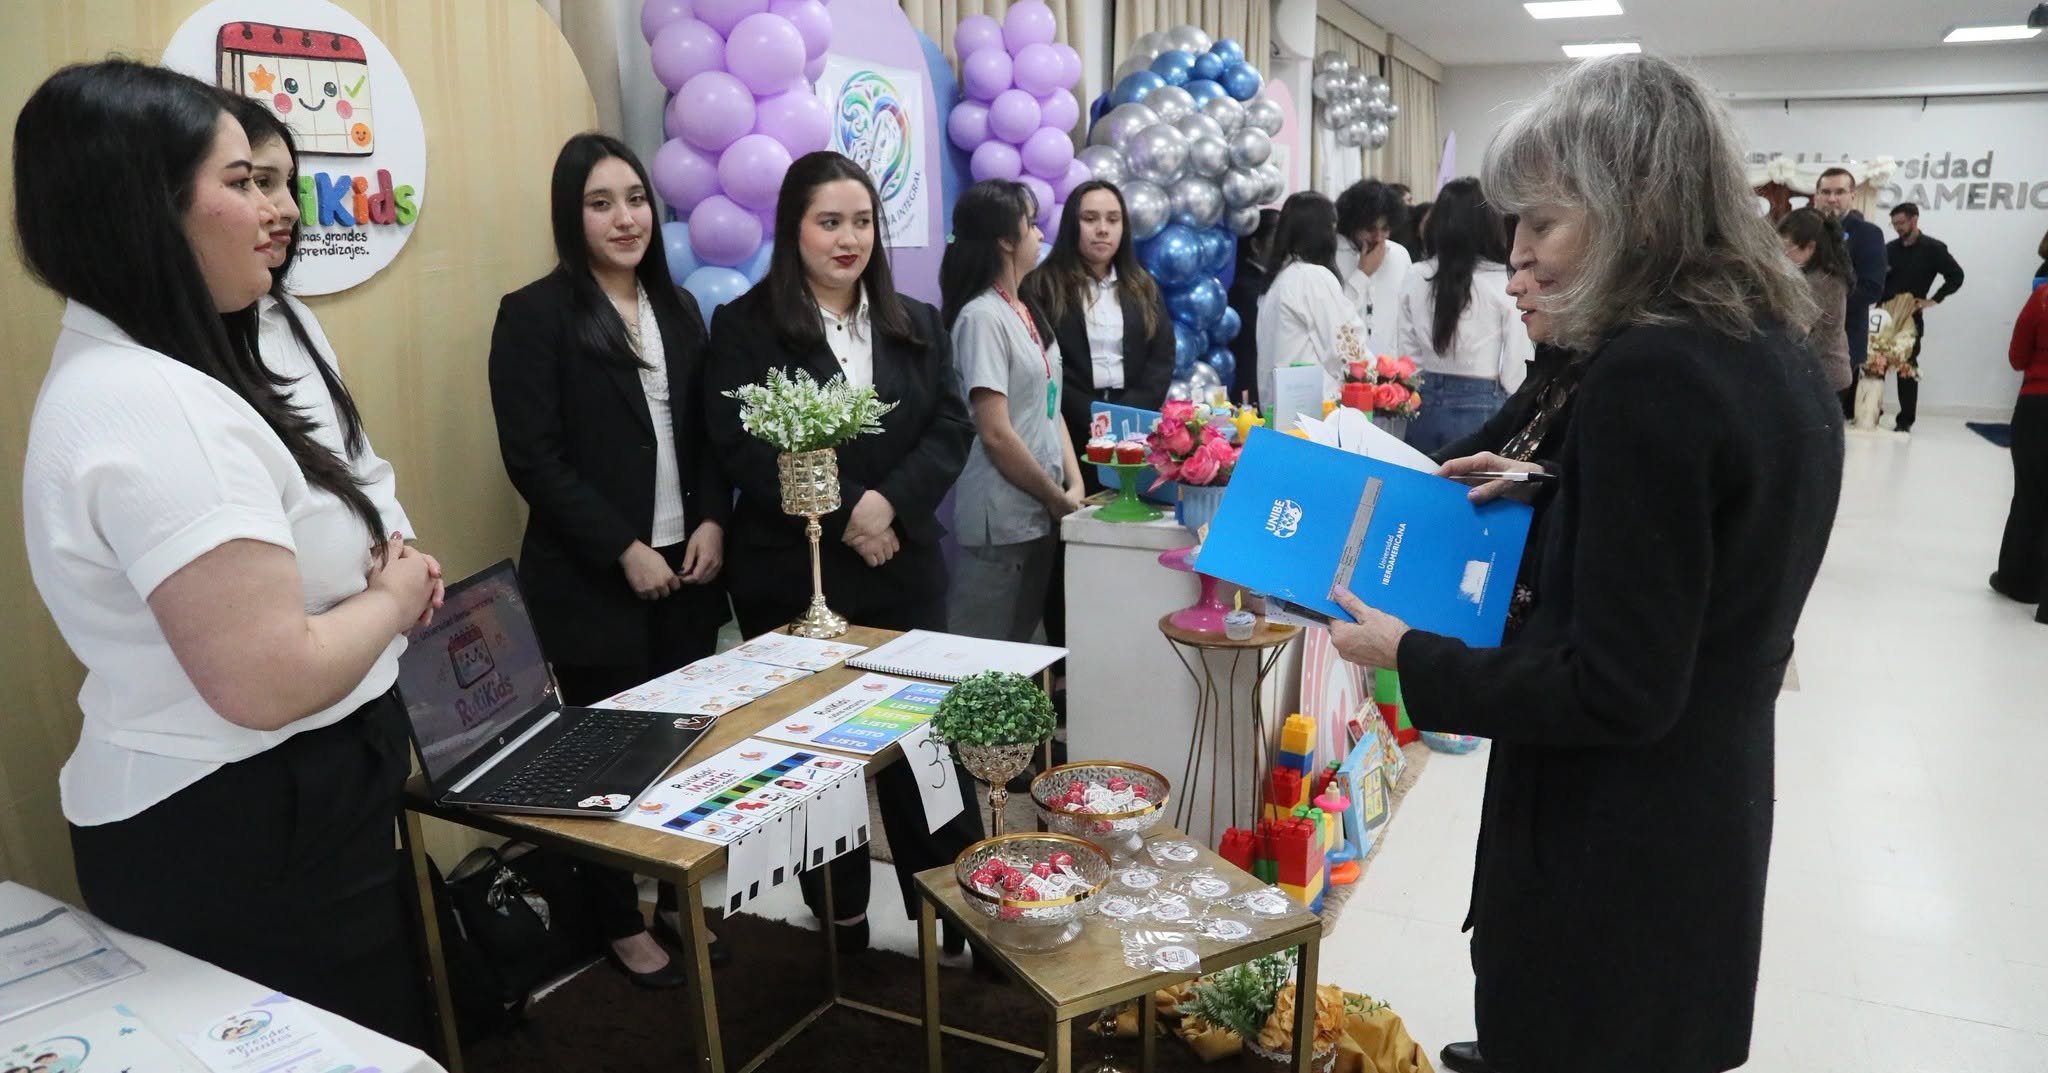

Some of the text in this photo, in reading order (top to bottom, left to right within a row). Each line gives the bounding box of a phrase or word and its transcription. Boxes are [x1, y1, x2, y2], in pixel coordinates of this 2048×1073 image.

[298, 243, 370, 262] prendizajes.
[1868, 314, 1882, 334] 9
[1265, 500, 1285, 530] UNIBE
[1378, 534, 1395, 569] Universidad
[1382, 522, 1407, 586] IBEROAMERICANA
[904, 694, 941, 704] LISTO
[889, 702, 926, 712] LISTO
[874, 710, 912, 720] LISTO
[860, 719, 899, 729] LISTO
[845, 728, 884, 738] LISTO
[830, 737, 868, 747] LISTO
[919, 739, 946, 789] 3
